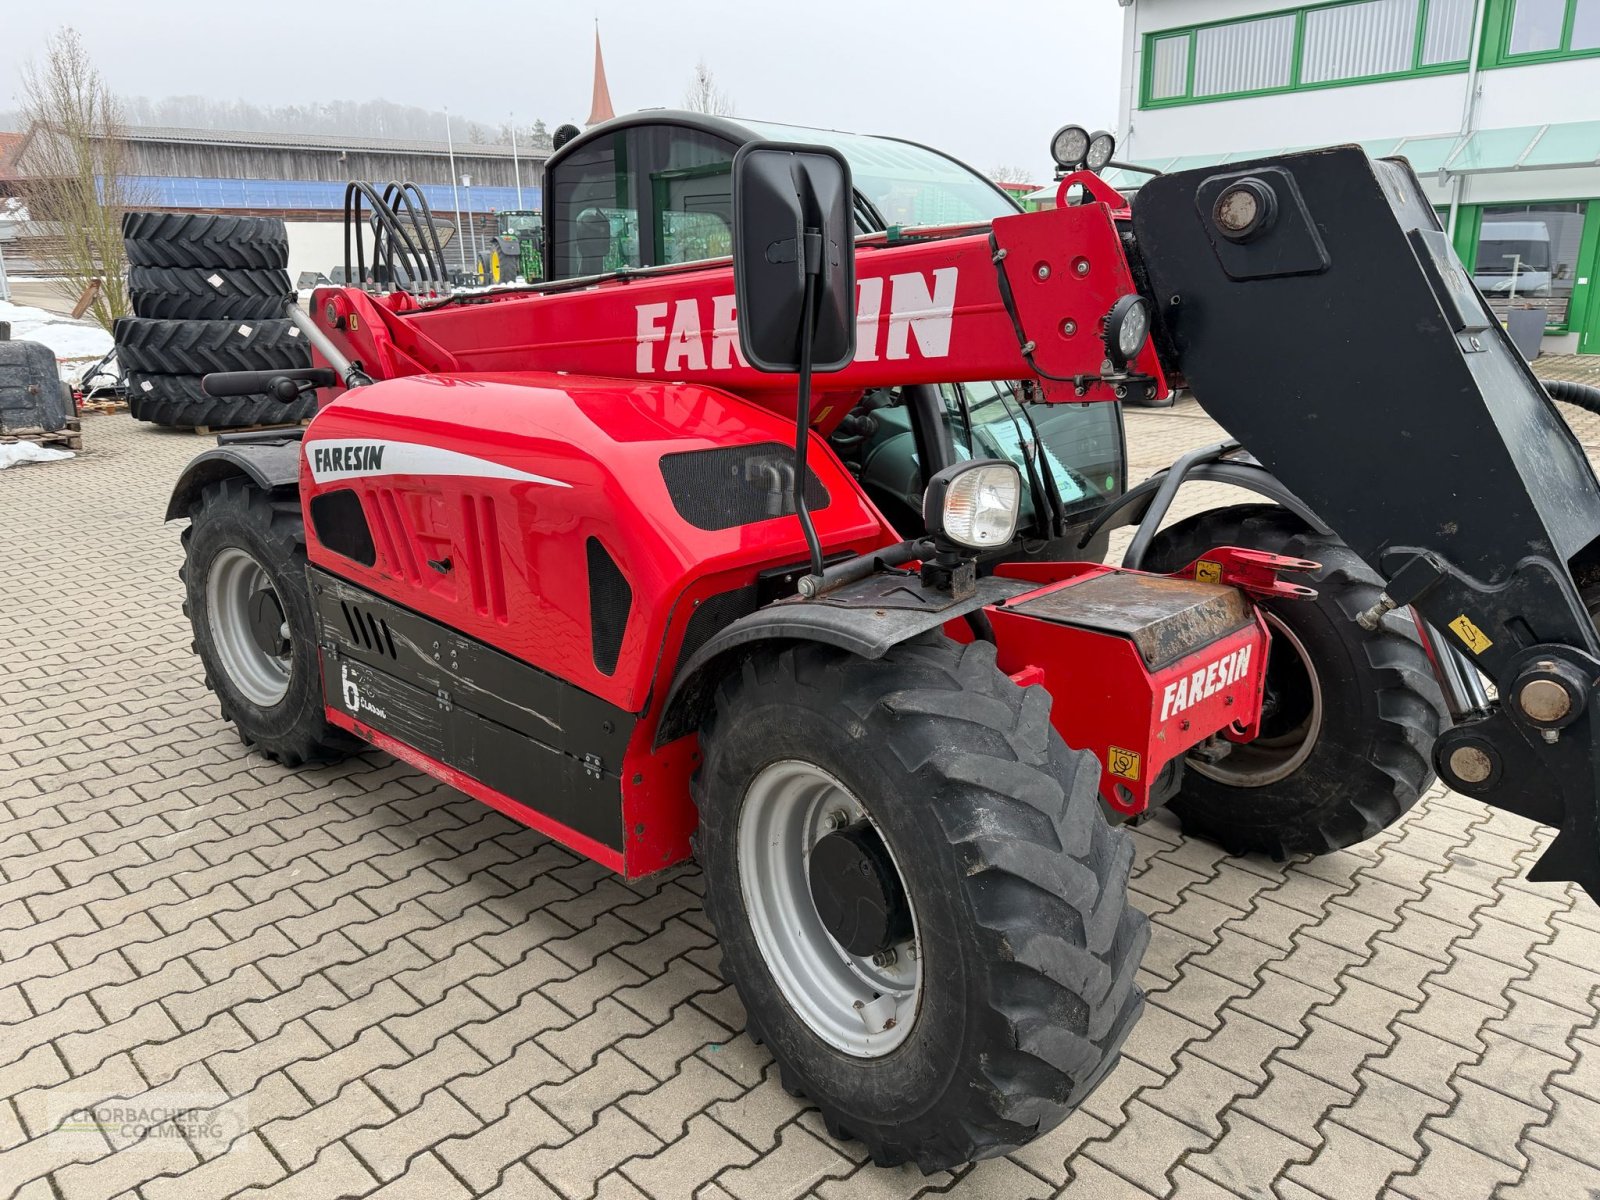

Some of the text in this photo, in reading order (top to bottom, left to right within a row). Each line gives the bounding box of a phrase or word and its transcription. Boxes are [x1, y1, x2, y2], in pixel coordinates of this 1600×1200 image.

[635, 267, 958, 373] FARIN
[315, 445, 386, 472] FARESIN
[1160, 644, 1252, 722] FARESIN
